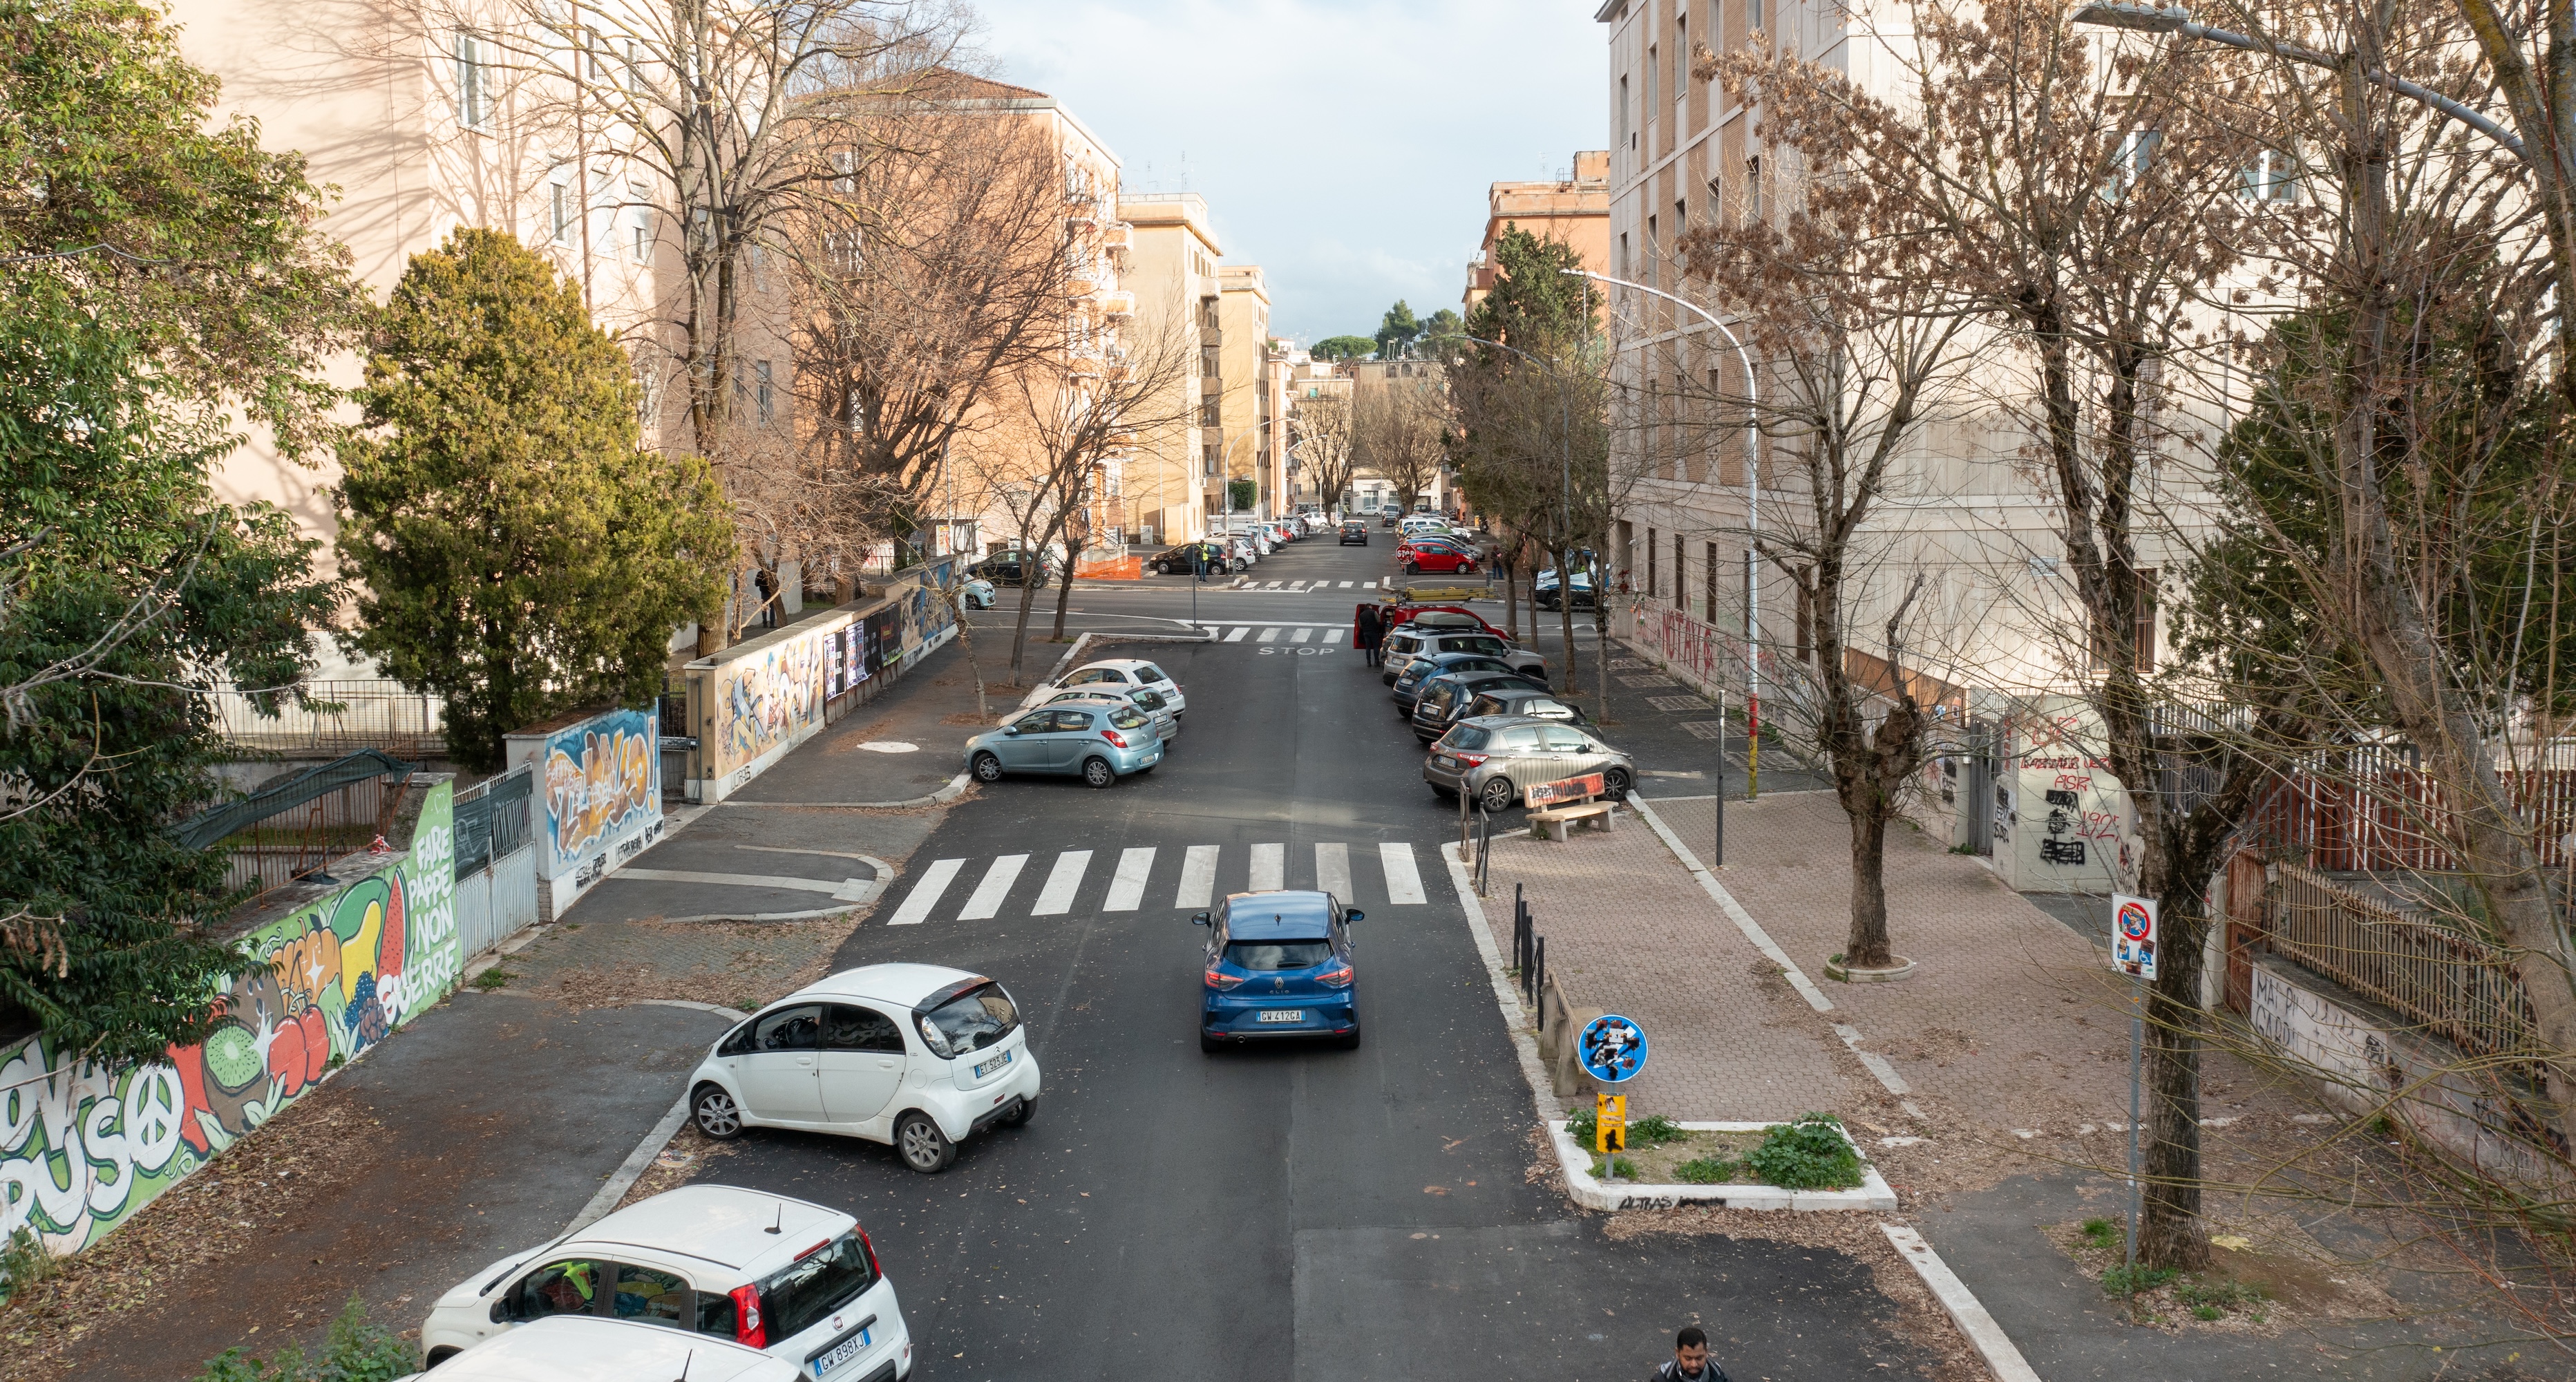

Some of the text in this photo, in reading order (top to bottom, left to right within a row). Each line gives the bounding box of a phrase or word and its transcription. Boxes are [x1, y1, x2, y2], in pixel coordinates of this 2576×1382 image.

[1258, 647, 1335, 655] STOP
[416, 825, 453, 871] FARE
[408, 862, 453, 912] PAPPE
[415, 897, 455, 955] NON
[1262, 1012, 1300, 1021] GW 412GA
[980, 1052, 1007, 1075] ET 523JE
[822, 1333, 864, 1370] GW 898XJ
